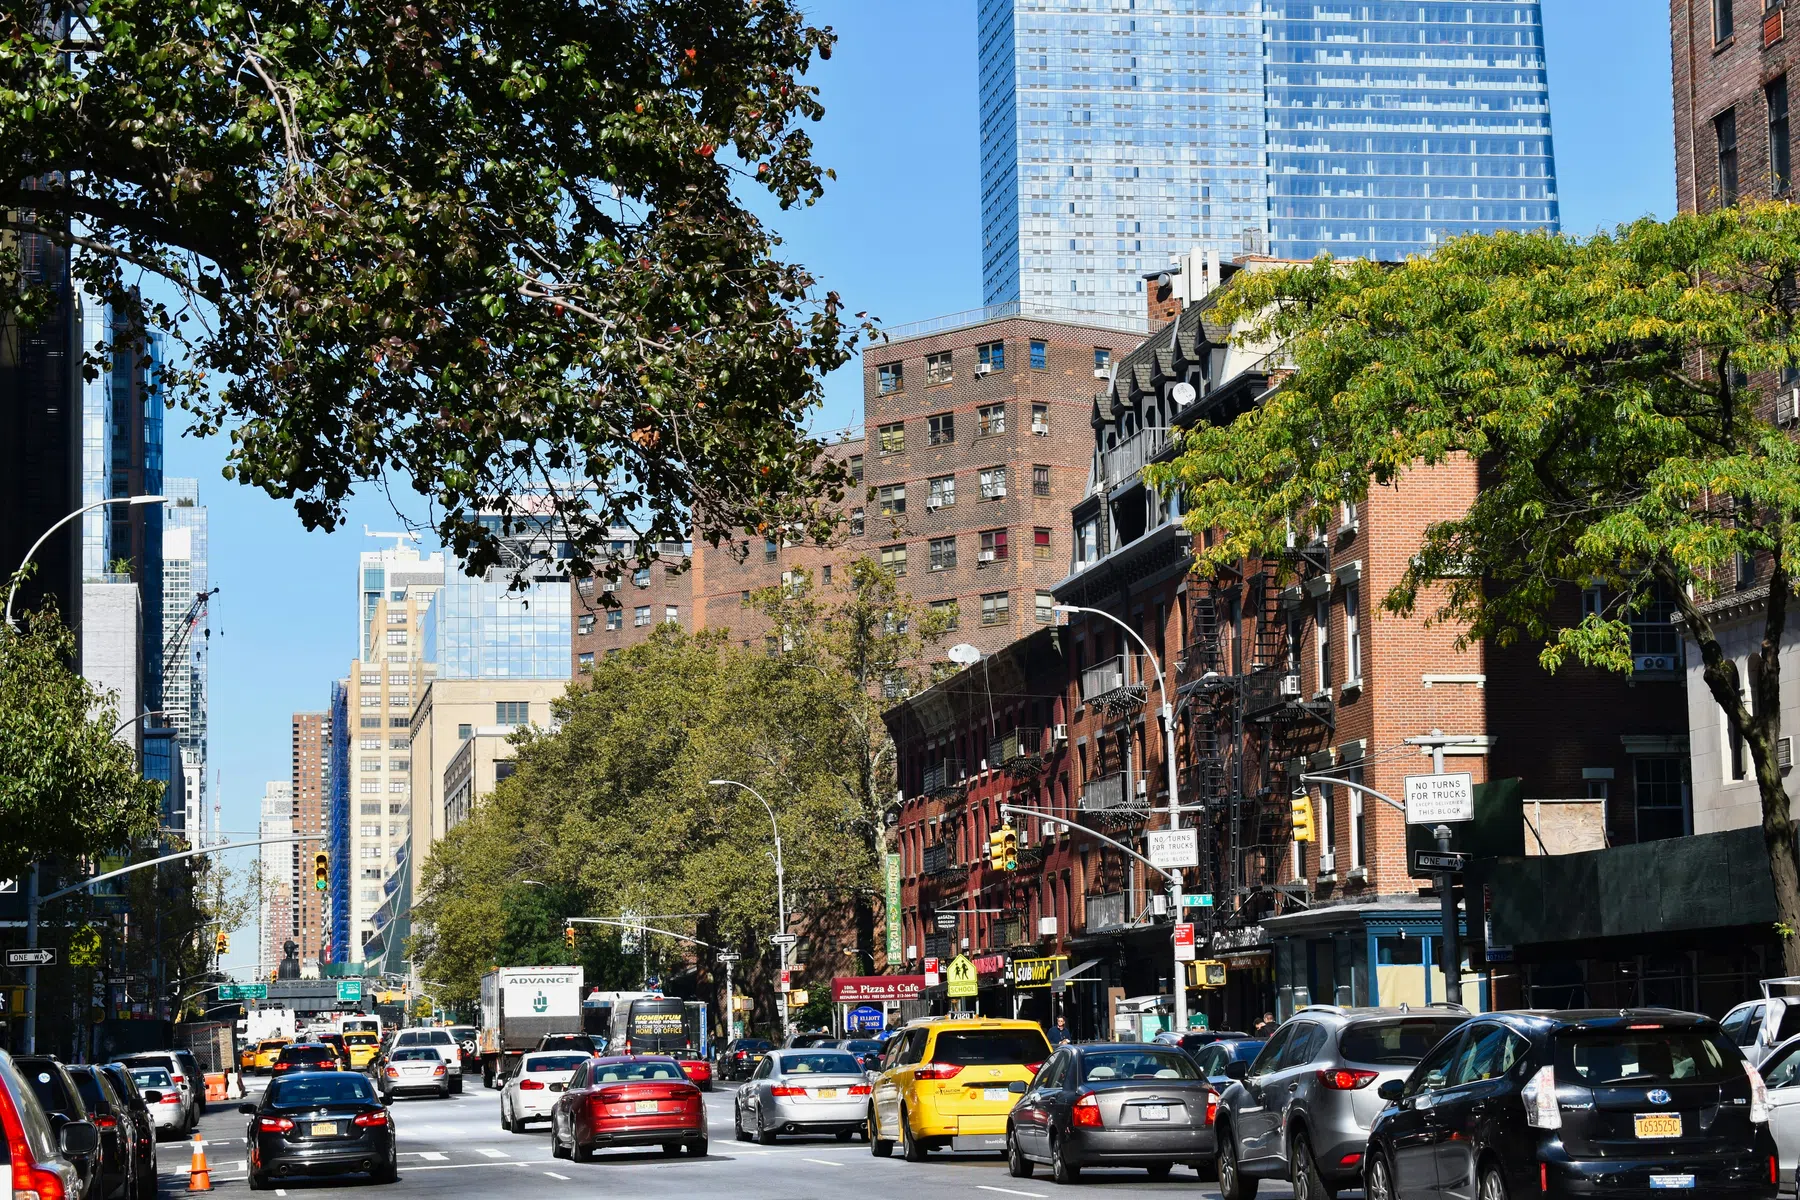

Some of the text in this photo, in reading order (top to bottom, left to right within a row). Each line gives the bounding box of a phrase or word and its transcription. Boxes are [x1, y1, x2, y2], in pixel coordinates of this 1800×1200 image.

[1432, 780, 1461, 789] TURNS
[1432, 790, 1466, 799] TRUCKS
[1184, 896, 1190, 904] W
[1194, 896, 1203, 904] 24
[1017, 965, 1050, 982] SUBWAY
[860, 984, 884, 993] Pizza
[897, 984, 919, 992] Cafe
[1639, 1120, 1677, 1132] T653525C
